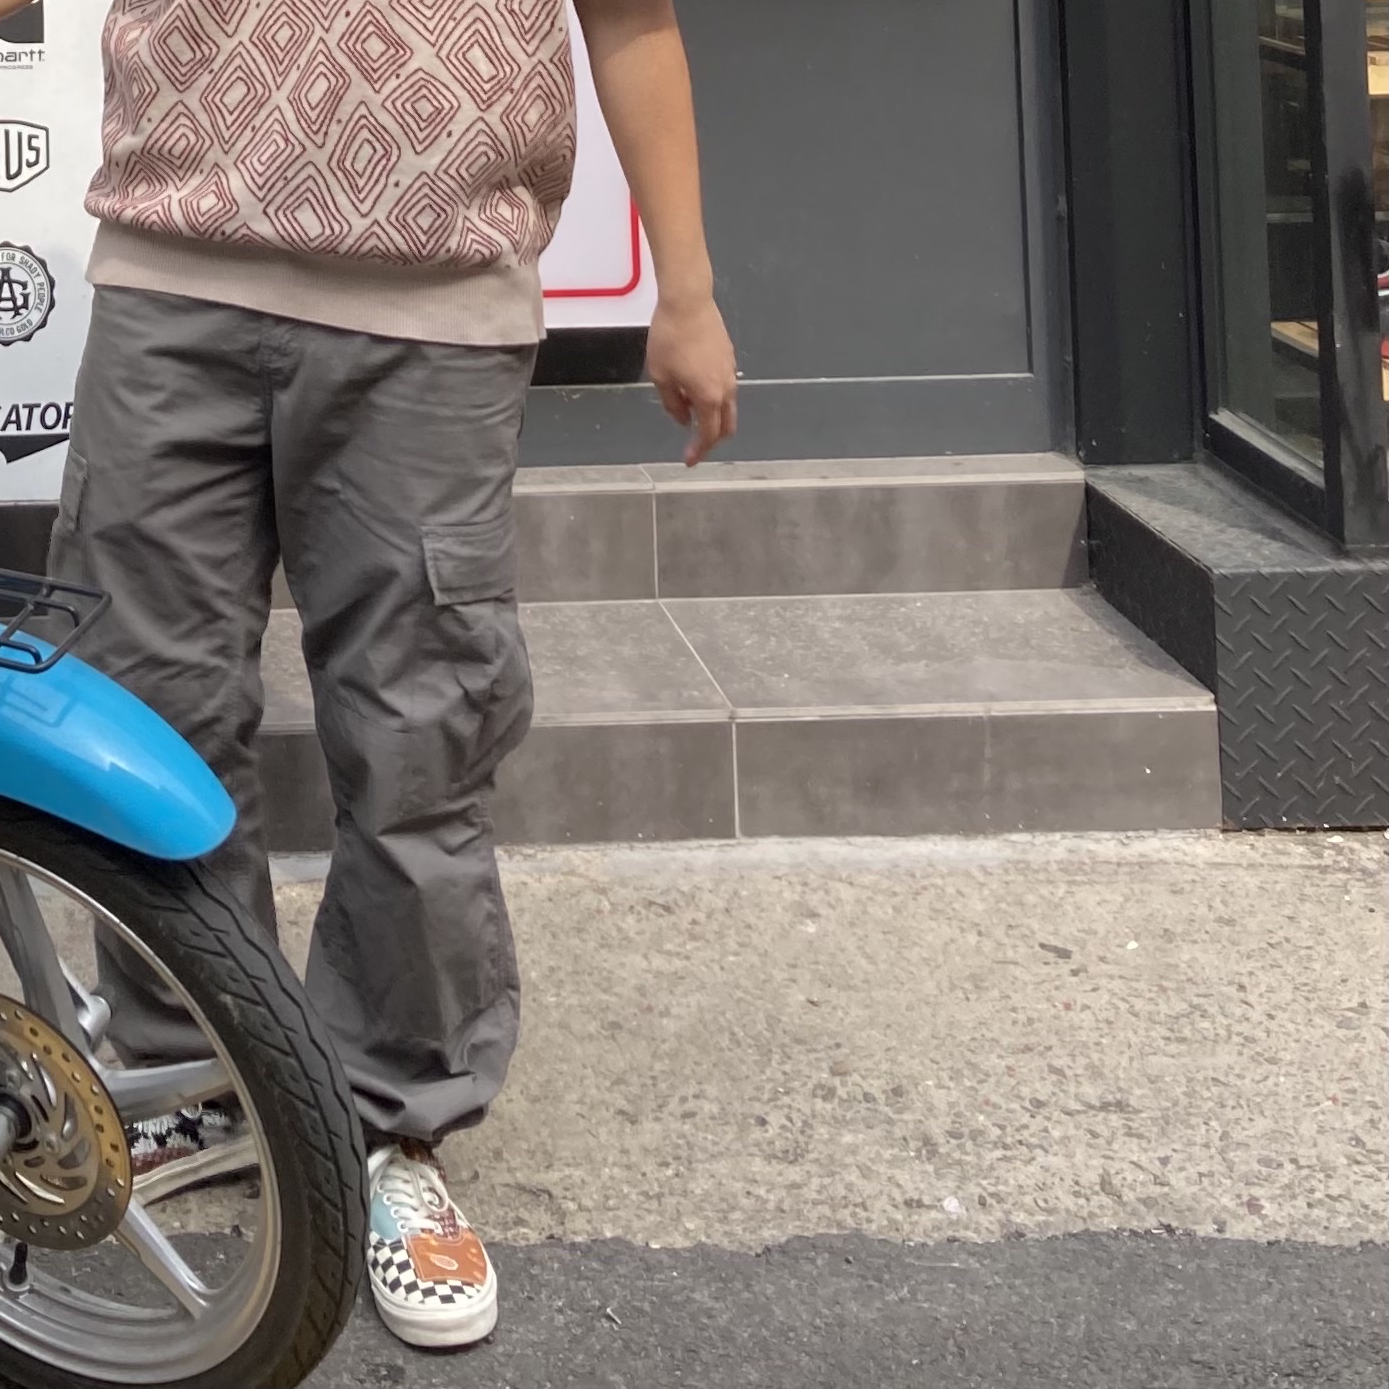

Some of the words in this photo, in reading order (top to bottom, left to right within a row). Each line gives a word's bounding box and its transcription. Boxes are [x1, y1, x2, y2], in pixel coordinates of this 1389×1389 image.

[1, 252, 16, 262] FOR
[19, 256, 42, 279] SHADY
[34, 282, 46, 313] PEOPLE
[15, 318, 33, 334] GOLD
